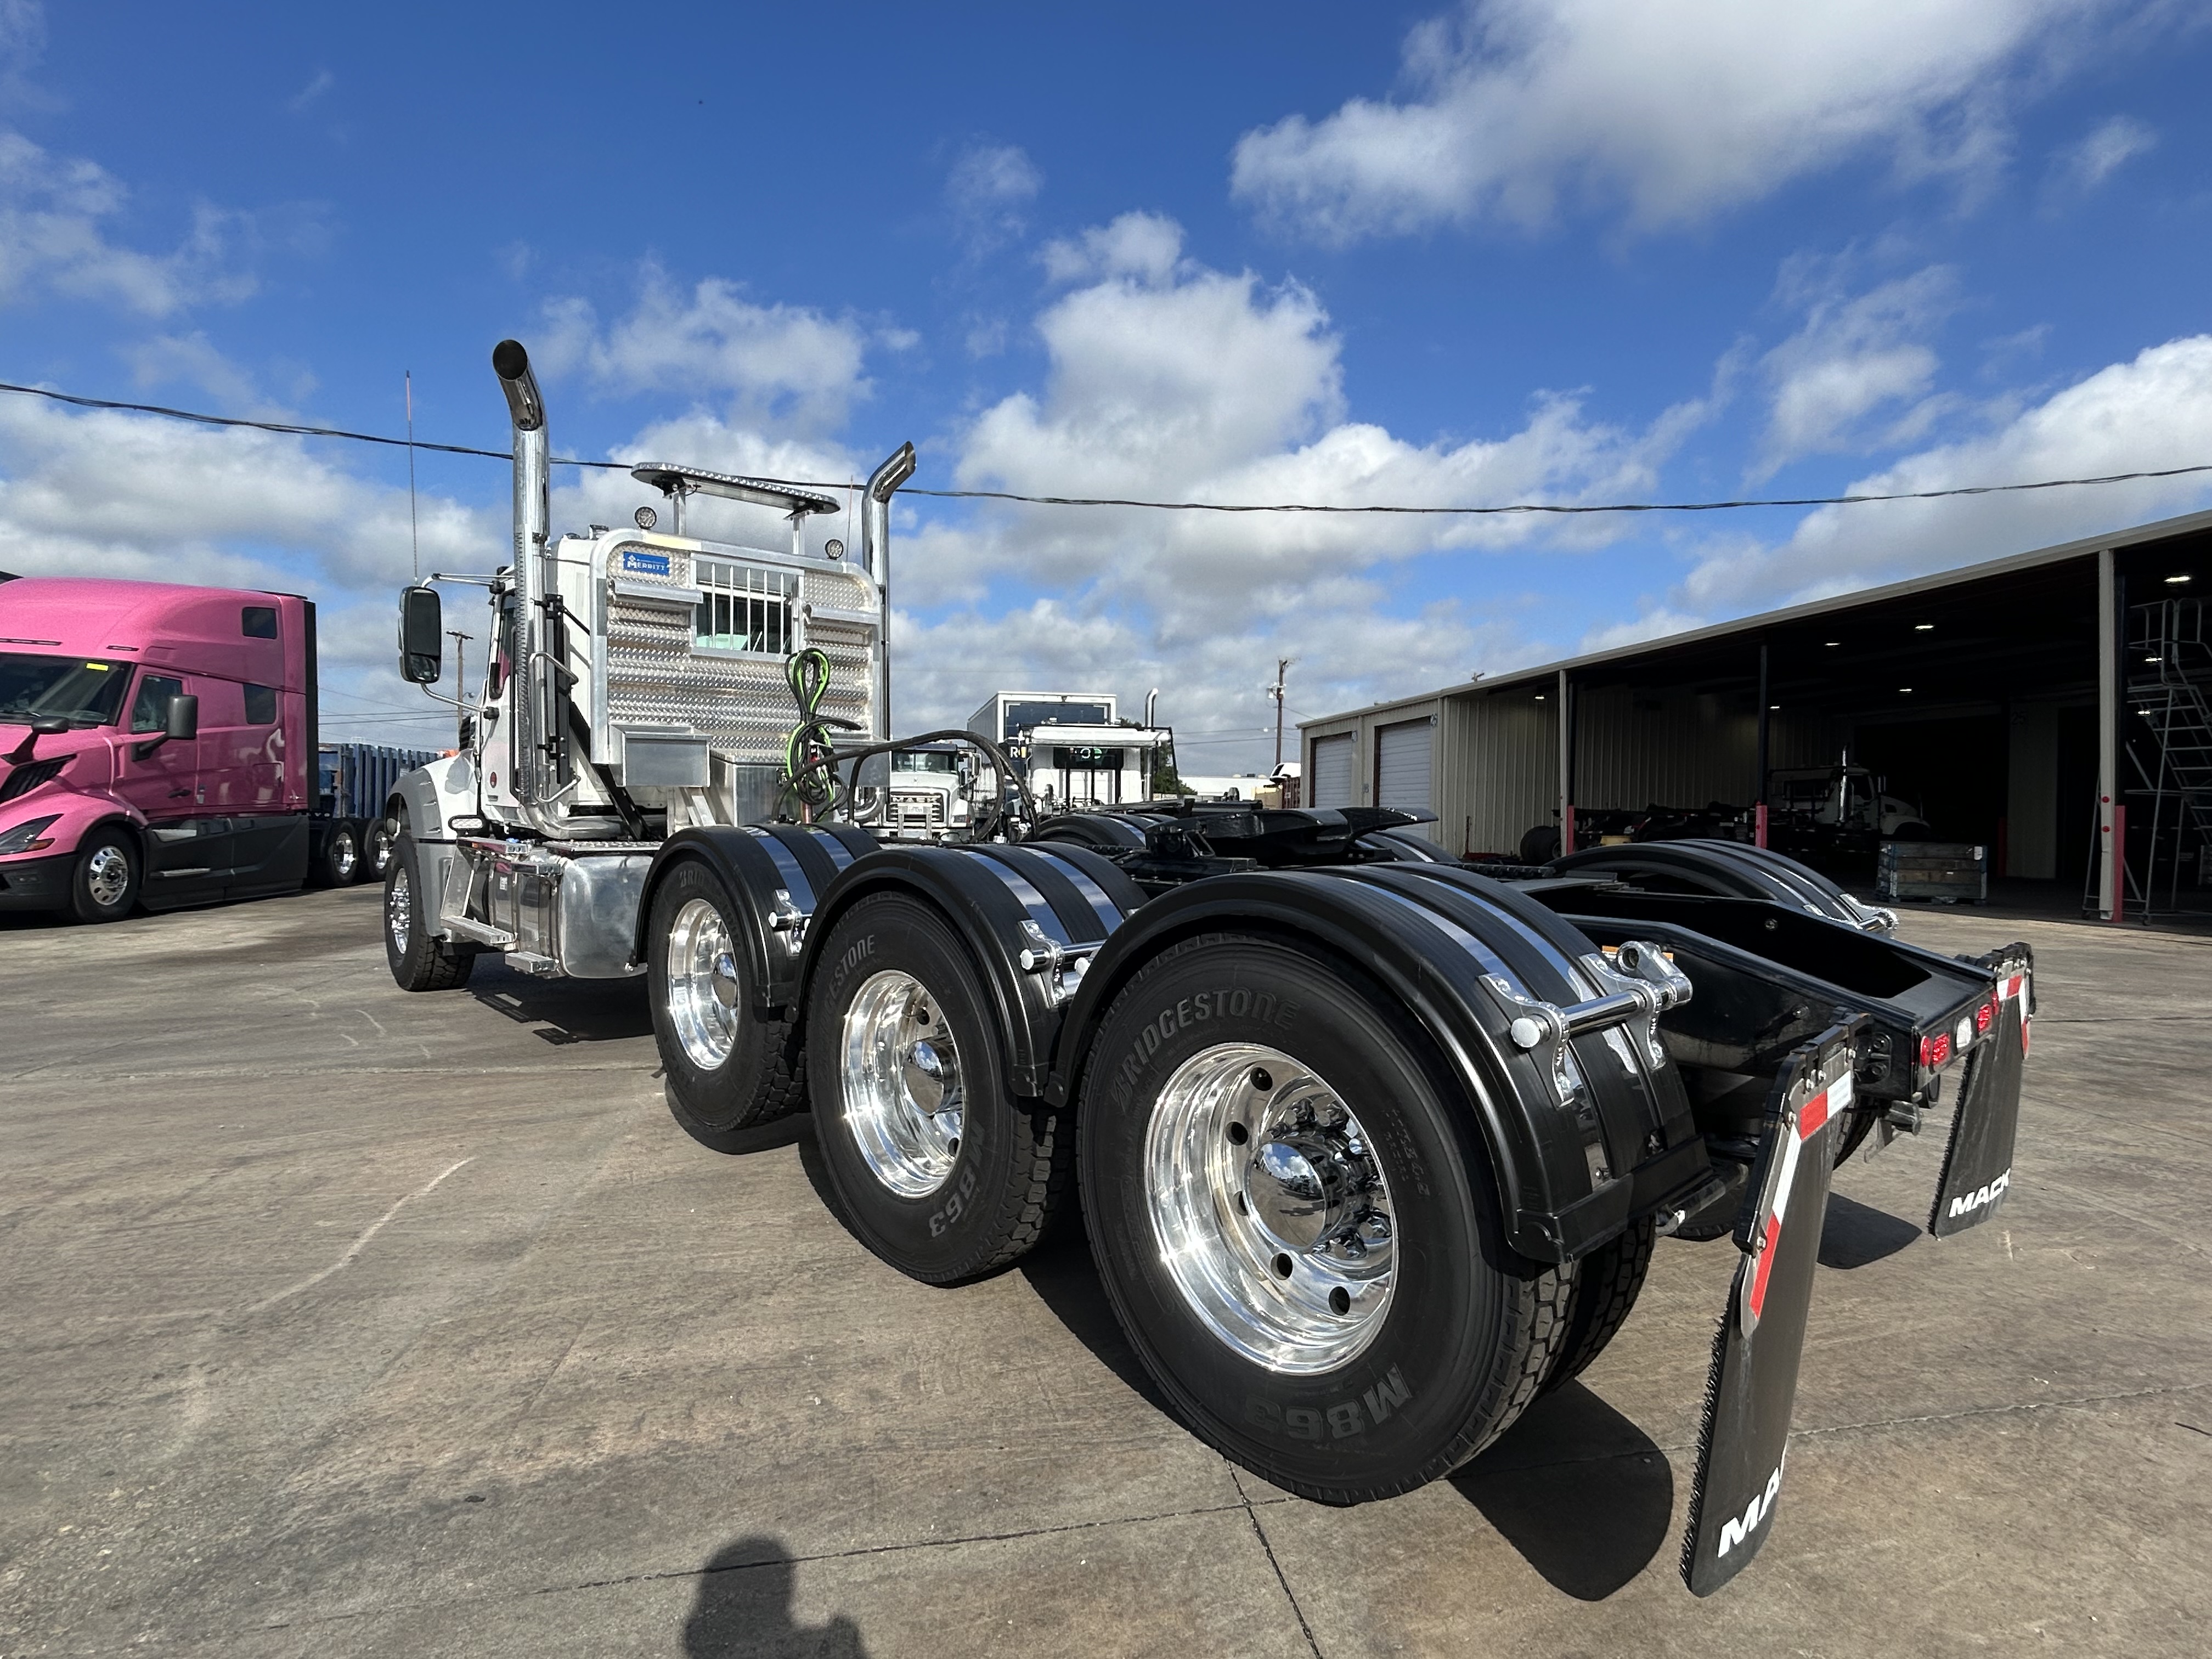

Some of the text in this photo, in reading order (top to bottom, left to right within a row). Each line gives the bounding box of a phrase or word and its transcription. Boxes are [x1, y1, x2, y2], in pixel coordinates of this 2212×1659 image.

[627, 561, 664, 571] MERRITT
[1110, 986, 1299, 1114] BRIDGESTONE
[1949, 1167, 2011, 1218] MACK
[1717, 1437, 1787, 1558] MA
